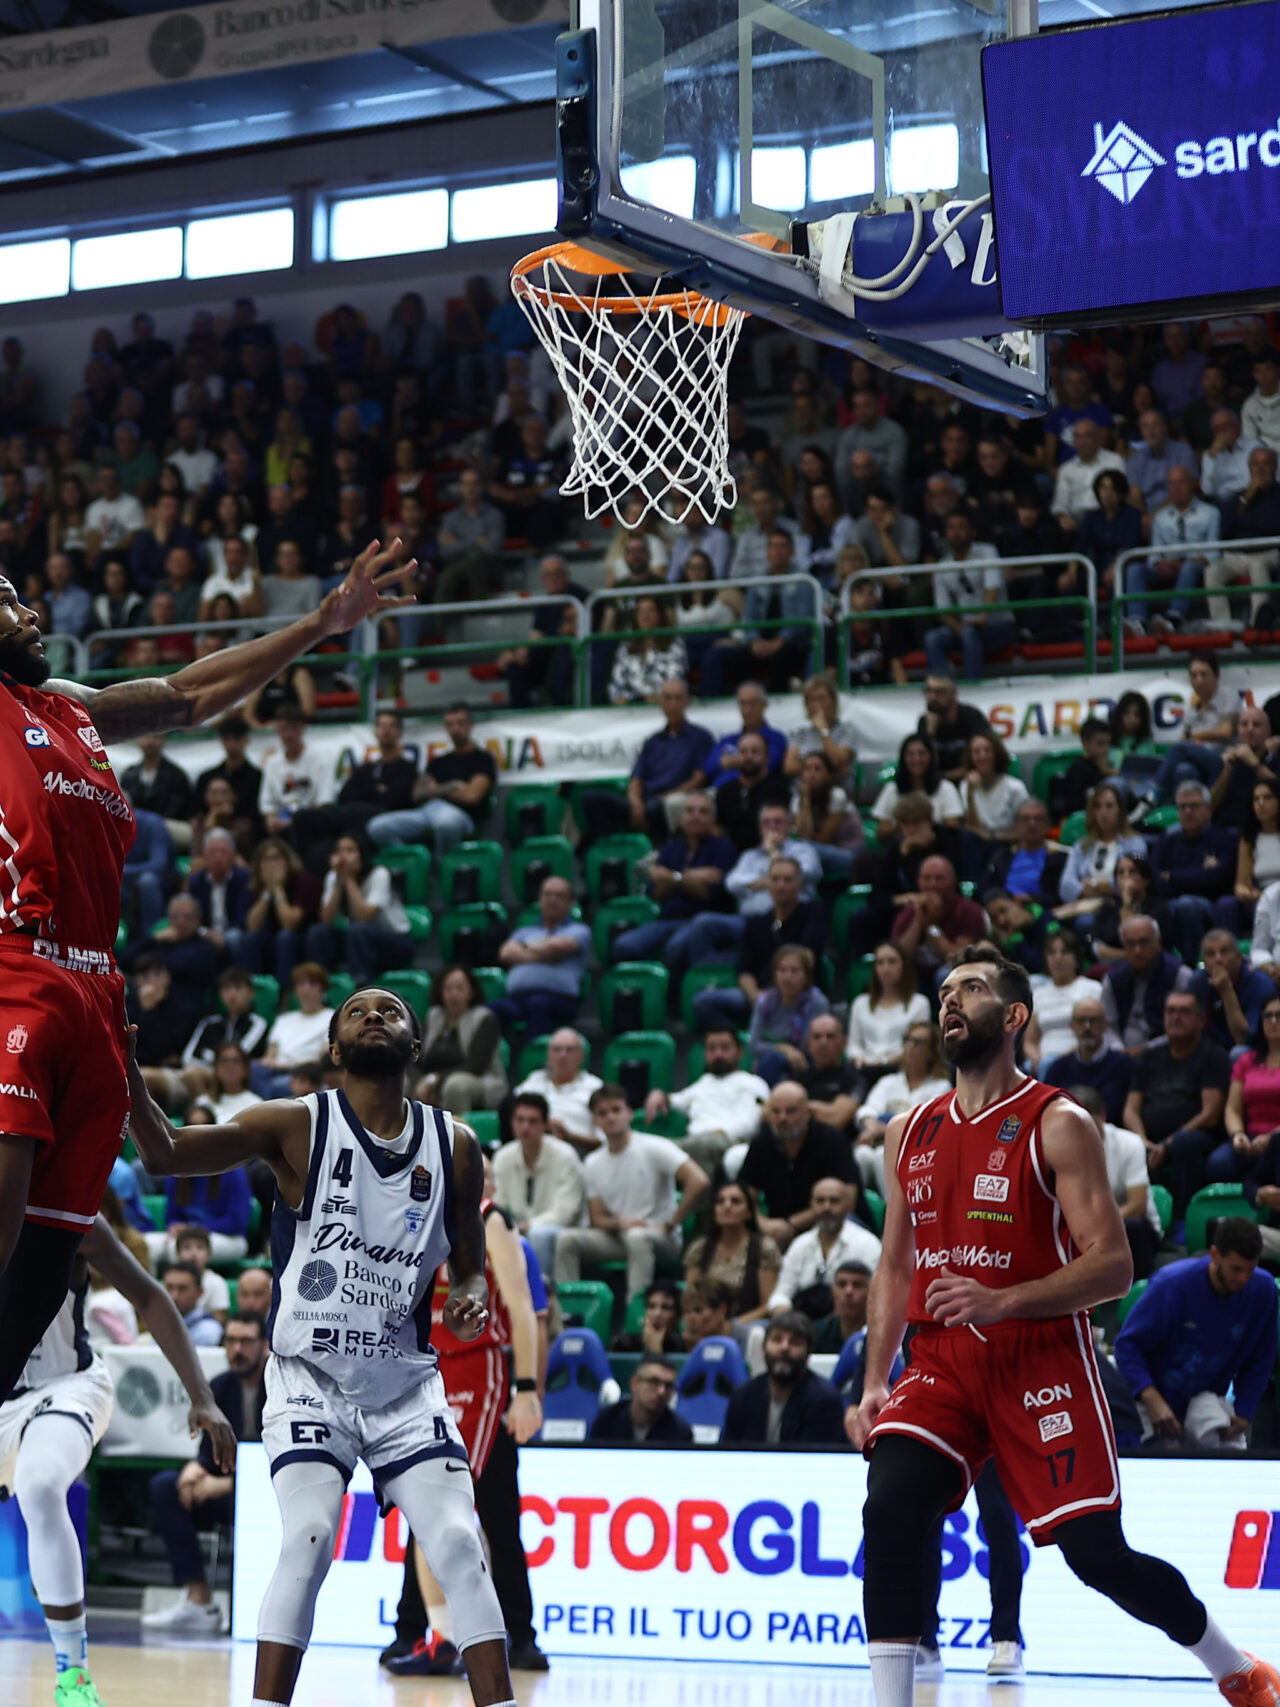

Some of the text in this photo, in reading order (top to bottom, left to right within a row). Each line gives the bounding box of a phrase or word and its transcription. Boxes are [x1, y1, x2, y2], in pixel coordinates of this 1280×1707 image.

[989, 689, 1258, 738] SARDG
[32, 938, 111, 975] OLIMPIA
[916, 1114, 945, 1148] 17
[332, 1147, 354, 1188] 4
[908, 1149, 937, 1170] EA7
[977, 1177, 1007, 1191] EA7
[310, 1222, 424, 1268] Dinamo
[343, 1260, 402, 1295] Banco
[340, 1283, 412, 1319] Sardeg
[1023, 1382, 1073, 1411] AON
[1048, 1448, 1076, 1488] 17
[543, 1604, 615, 1638] PER
[629, 1607, 659, 1637] IL
[672, 1609, 753, 1642] TUO
